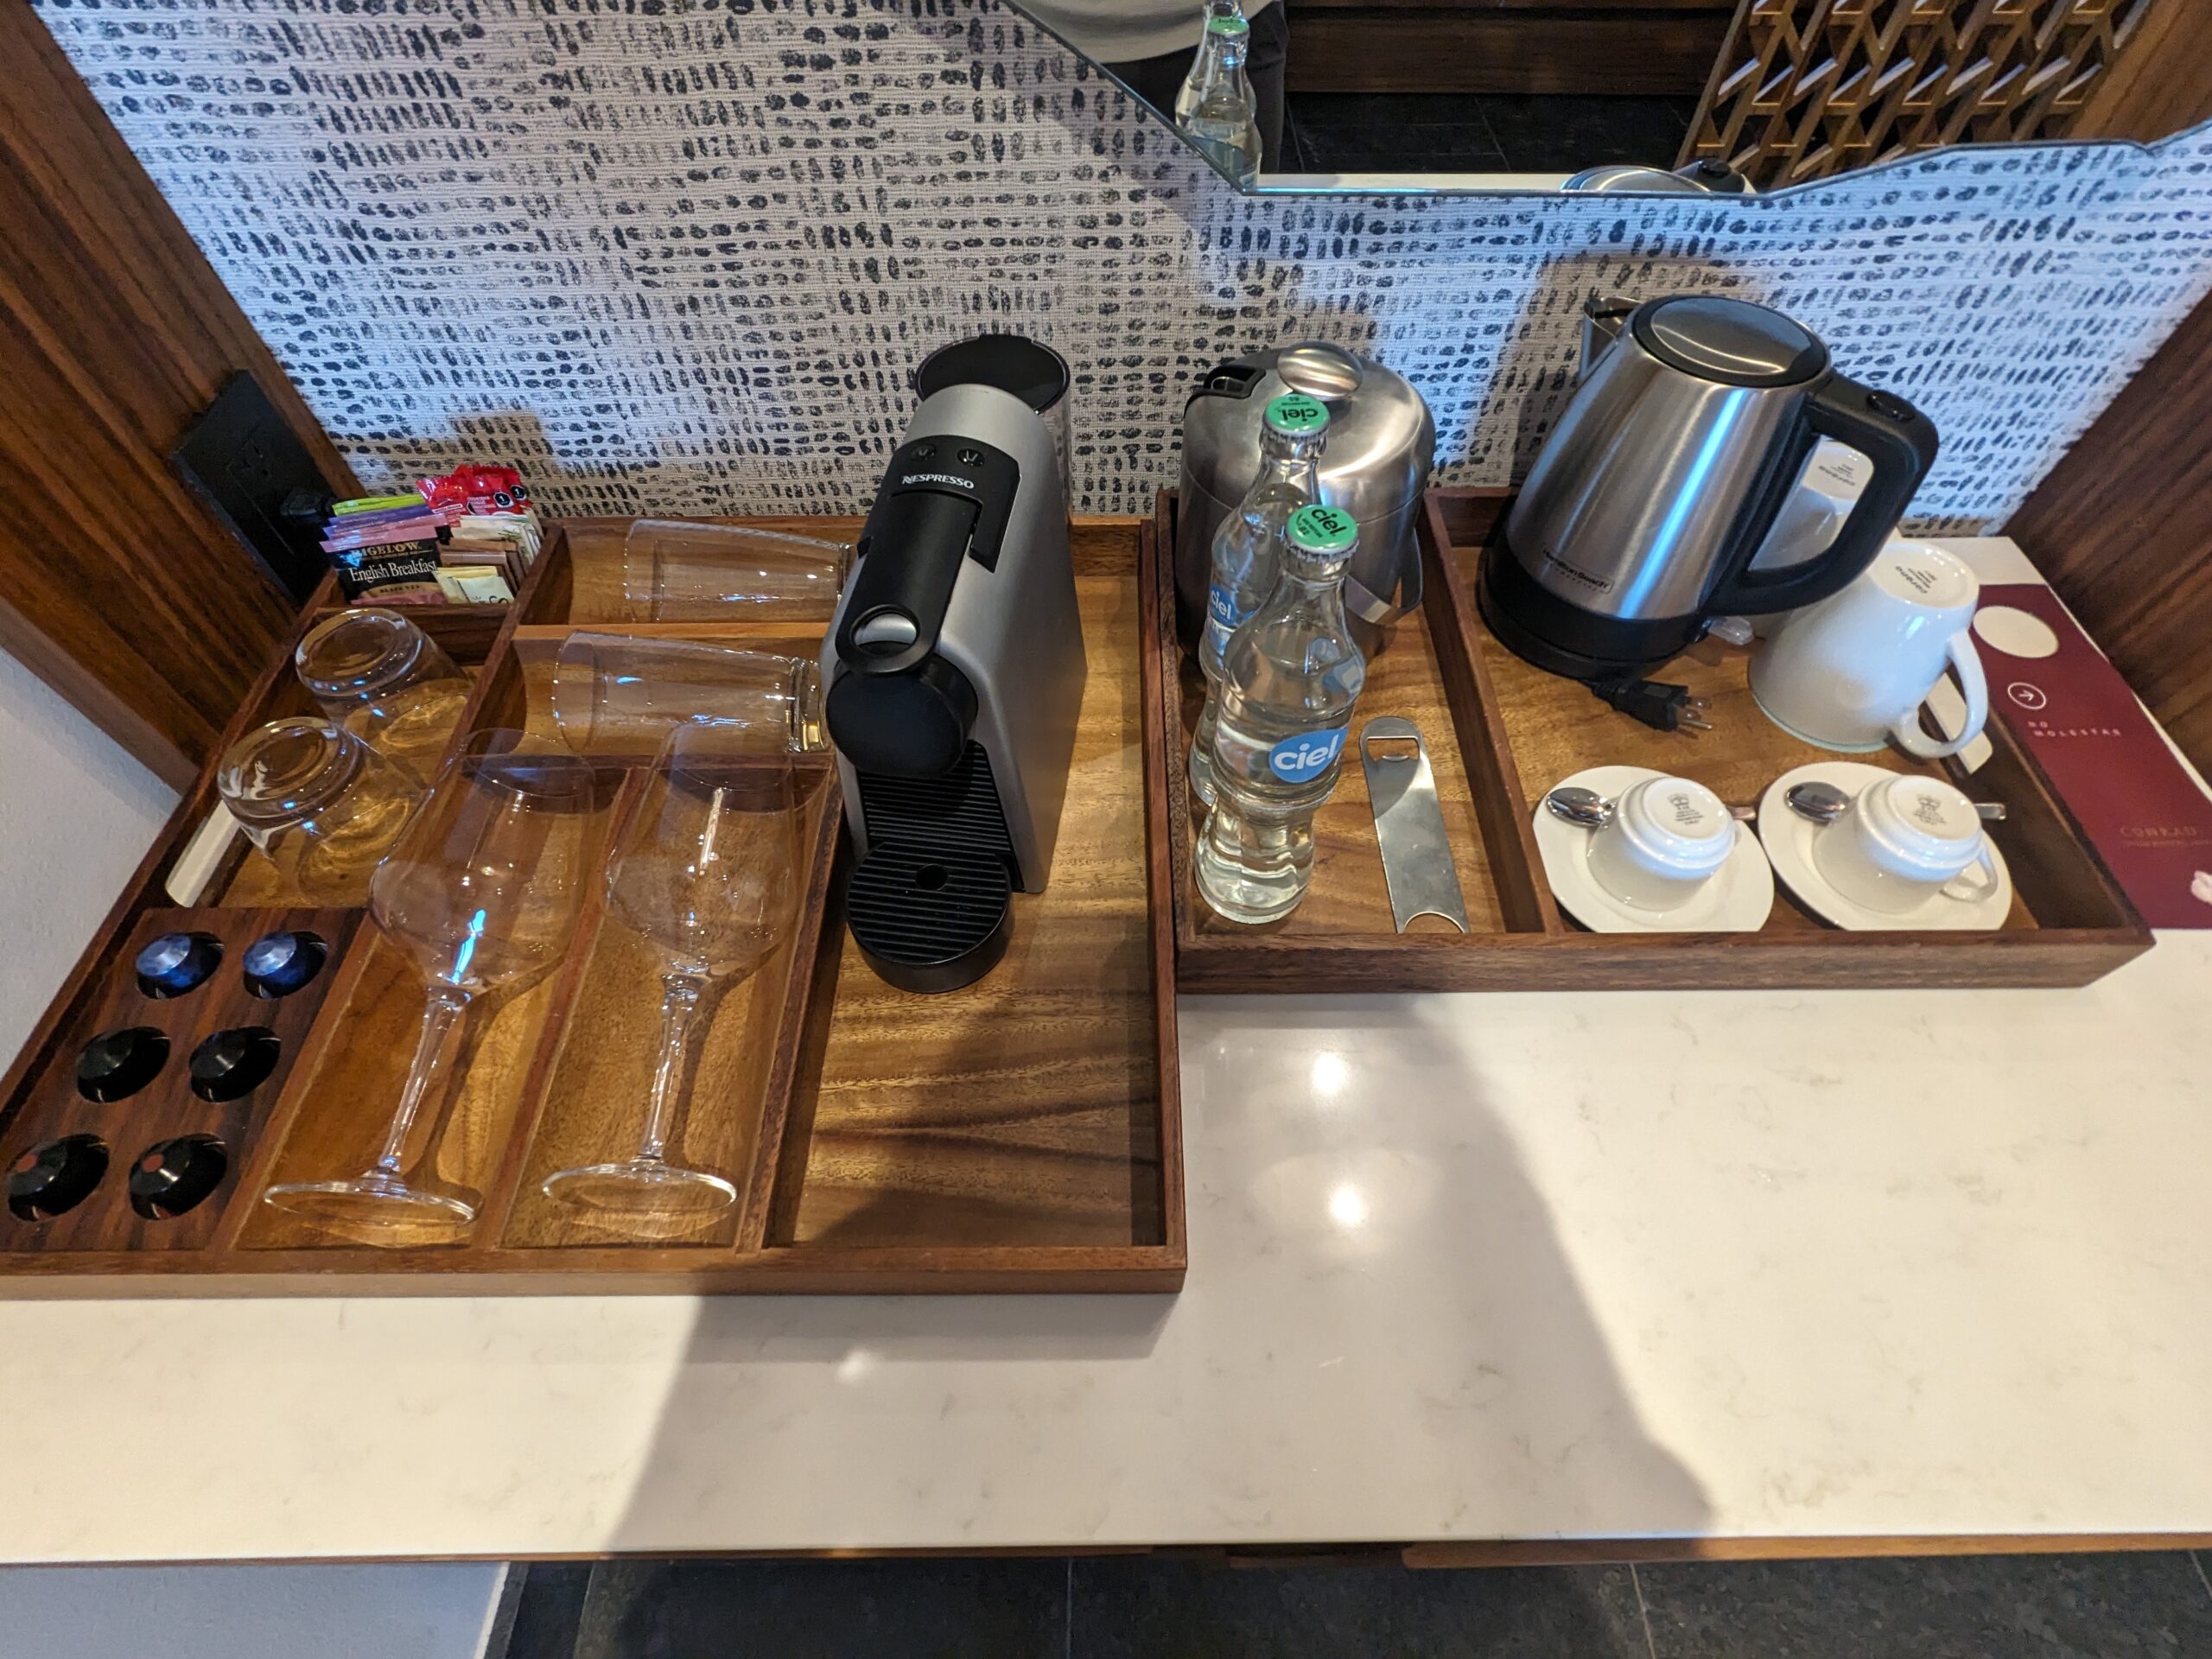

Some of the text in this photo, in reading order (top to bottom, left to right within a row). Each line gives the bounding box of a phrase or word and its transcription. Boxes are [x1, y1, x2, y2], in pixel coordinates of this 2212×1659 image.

[1281, 408, 1319, 422] ciel
[901, 474, 975, 489] NESPRESSO
[1311, 508, 1347, 535] ciel
[348, 557, 438, 583] English Breakfast
[1211, 589, 1232, 620] ciel
[1274, 734, 1339, 770] ciel
